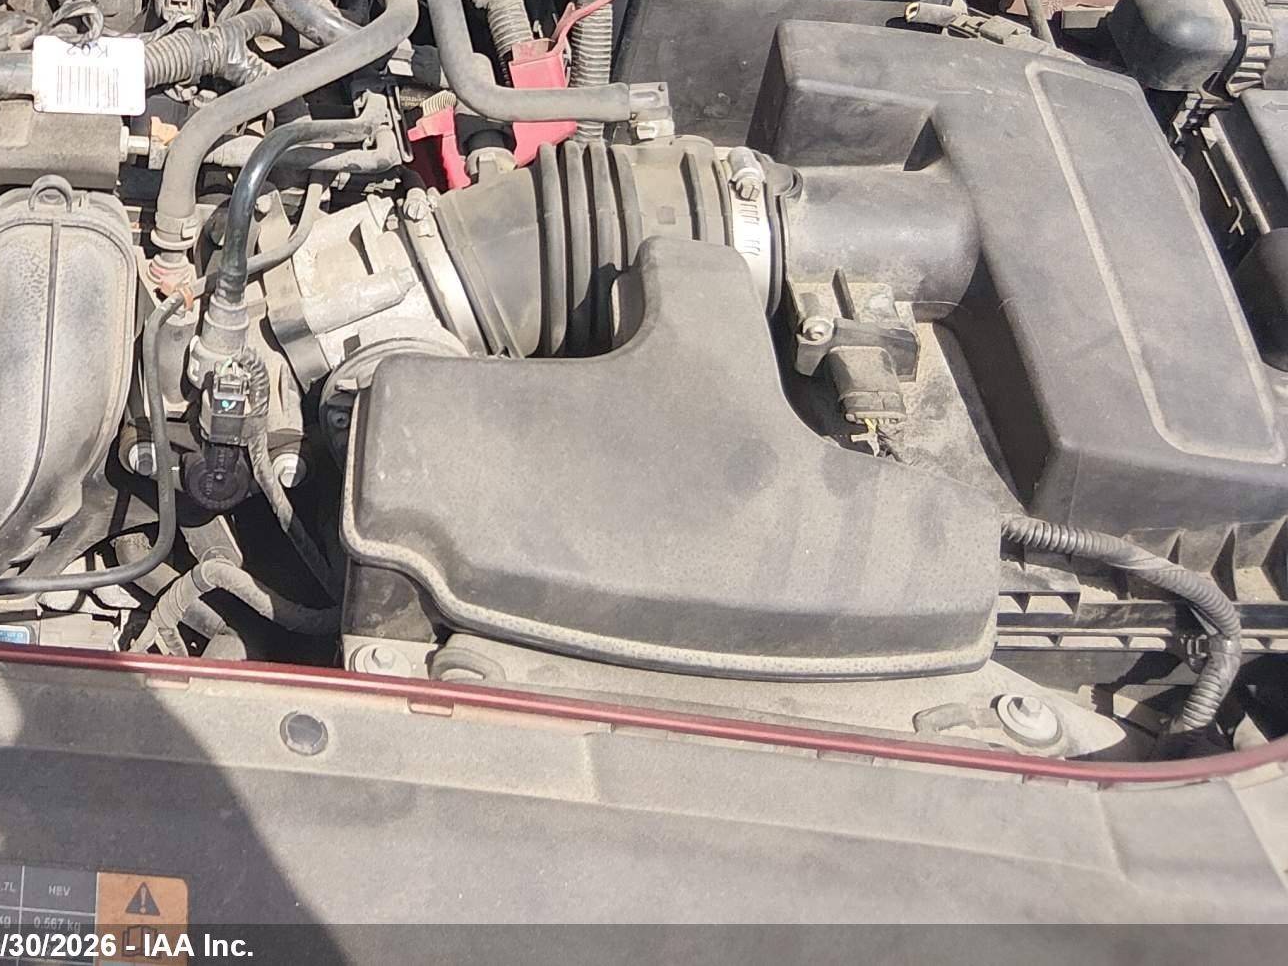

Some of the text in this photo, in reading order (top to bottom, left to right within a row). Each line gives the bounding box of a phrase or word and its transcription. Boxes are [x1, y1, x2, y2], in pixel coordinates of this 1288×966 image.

[48, 885, 72, 897] HEV
[33, 915, 82, 935] 0.567 kg
